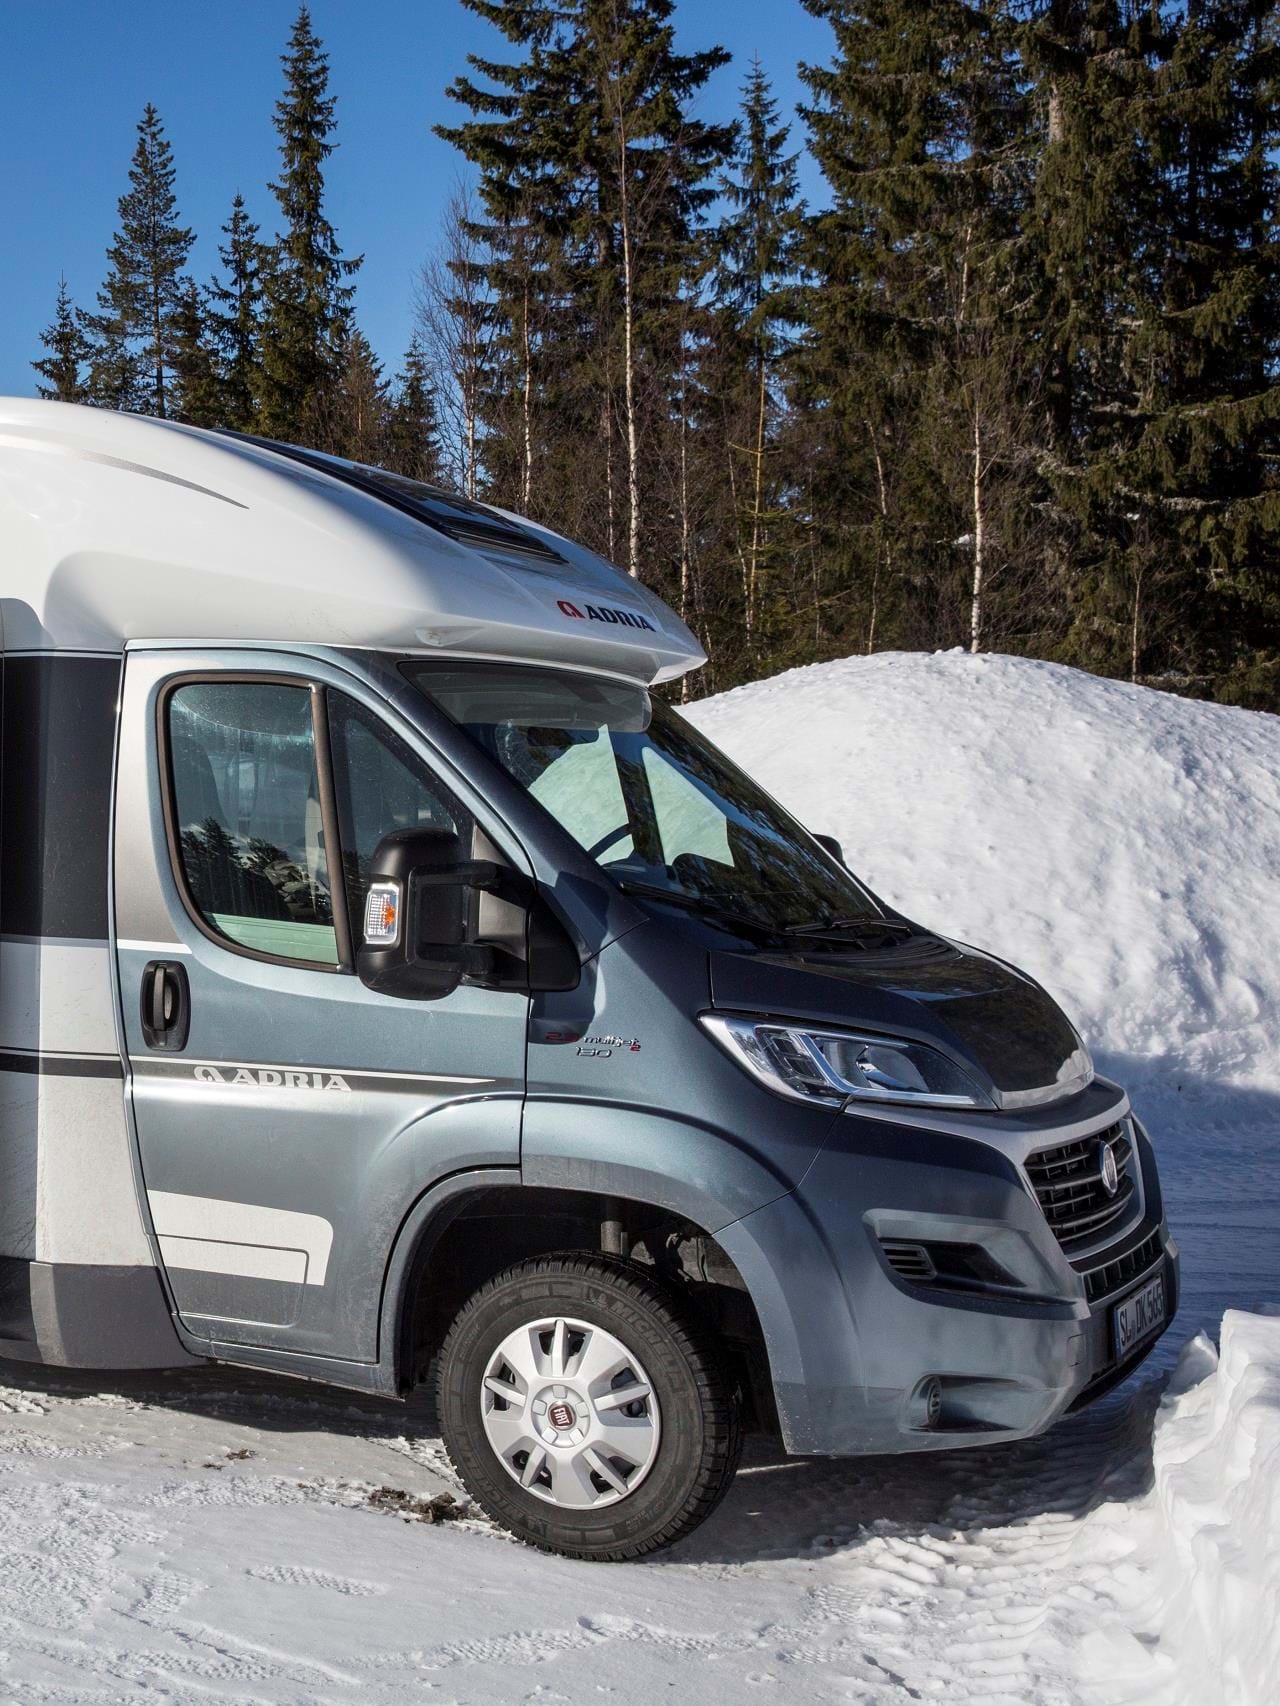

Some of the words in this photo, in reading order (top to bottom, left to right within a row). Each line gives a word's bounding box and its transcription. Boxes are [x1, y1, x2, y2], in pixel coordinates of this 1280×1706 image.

[584, 604, 657, 632] ADRIA
[576, 1046, 613, 1058] 130
[232, 1068, 352, 1092] ADRIA
[553, 1407, 570, 1425] FIAT
